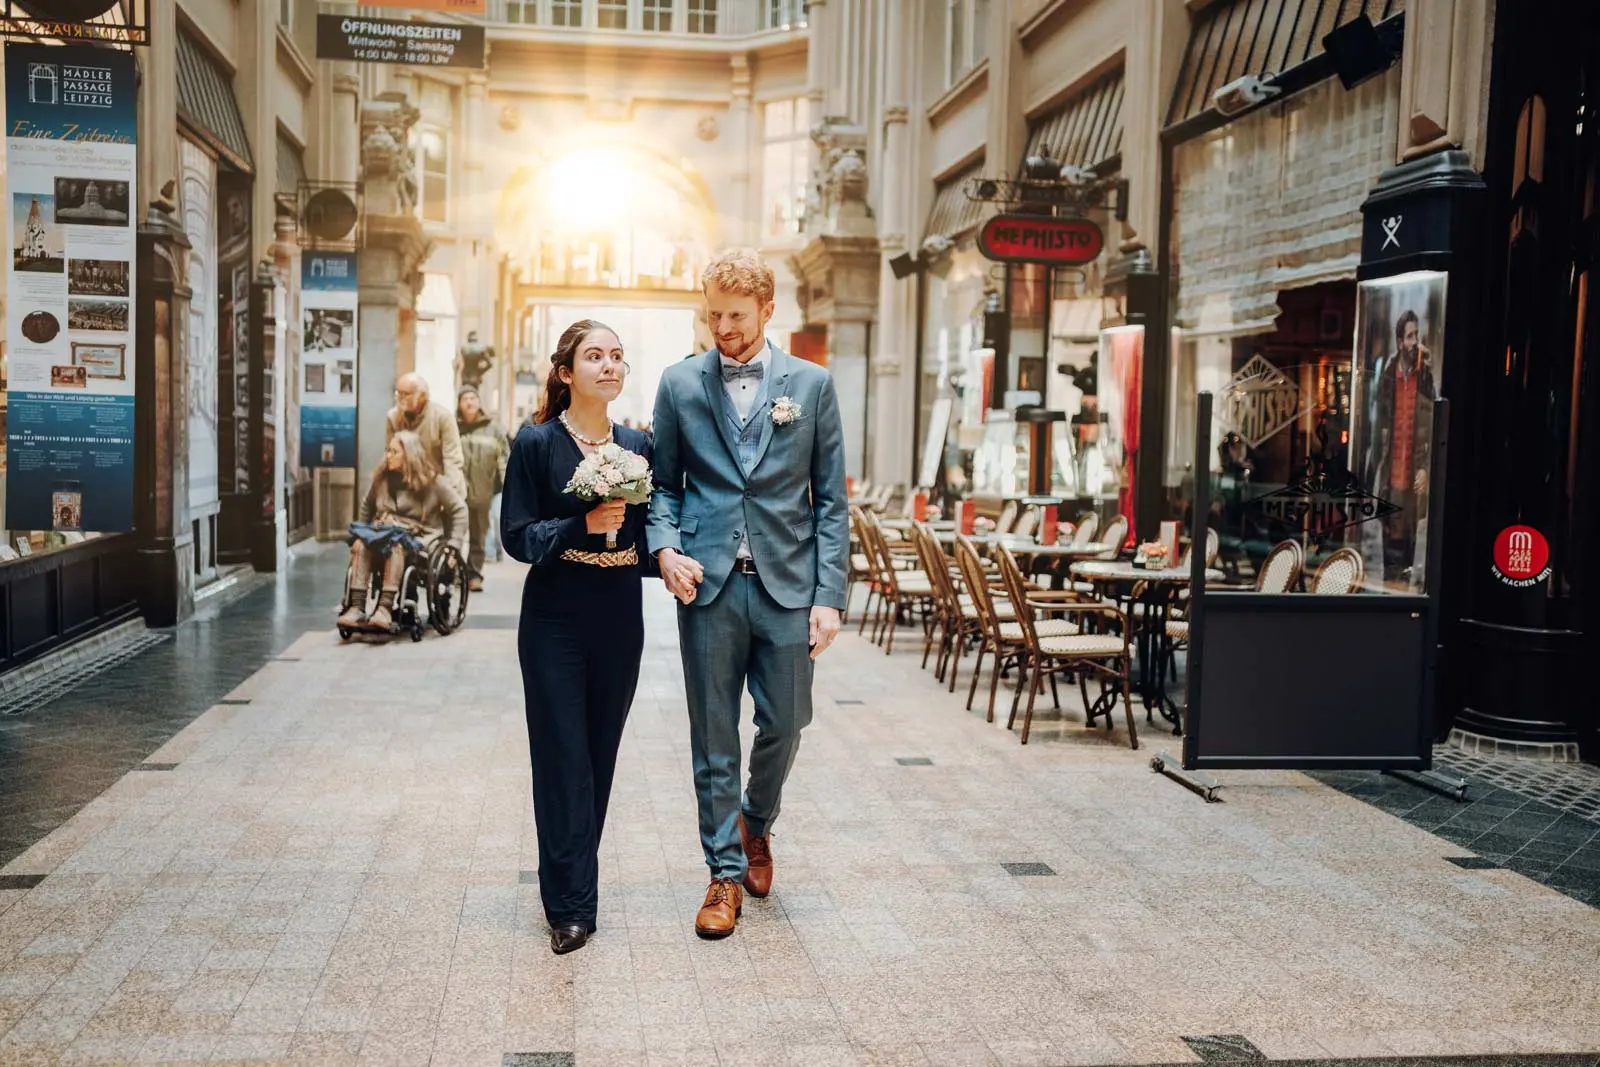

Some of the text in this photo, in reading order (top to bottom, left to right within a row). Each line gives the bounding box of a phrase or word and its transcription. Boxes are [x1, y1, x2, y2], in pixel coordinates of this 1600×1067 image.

[341, 19, 462, 41] ÖFFNUNGSZEITEN
[348, 36, 397, 48] Mittwoch
[407, 39, 455, 55] Samstag
[381, 50, 399, 60] Uhr
[432, 54, 450, 64] Uhr
[63, 68, 111, 80] MÄDLER
[63, 81, 112, 93] PASSAGE
[63, 94, 112, 105] LEIPZIG
[12, 119, 130, 145] Eine Zeitreise
[993, 227, 1092, 250] MEPHISTO
[1266, 502, 1374, 529] MEPHISTO
[1501, 577, 1536, 587] MACHEN
